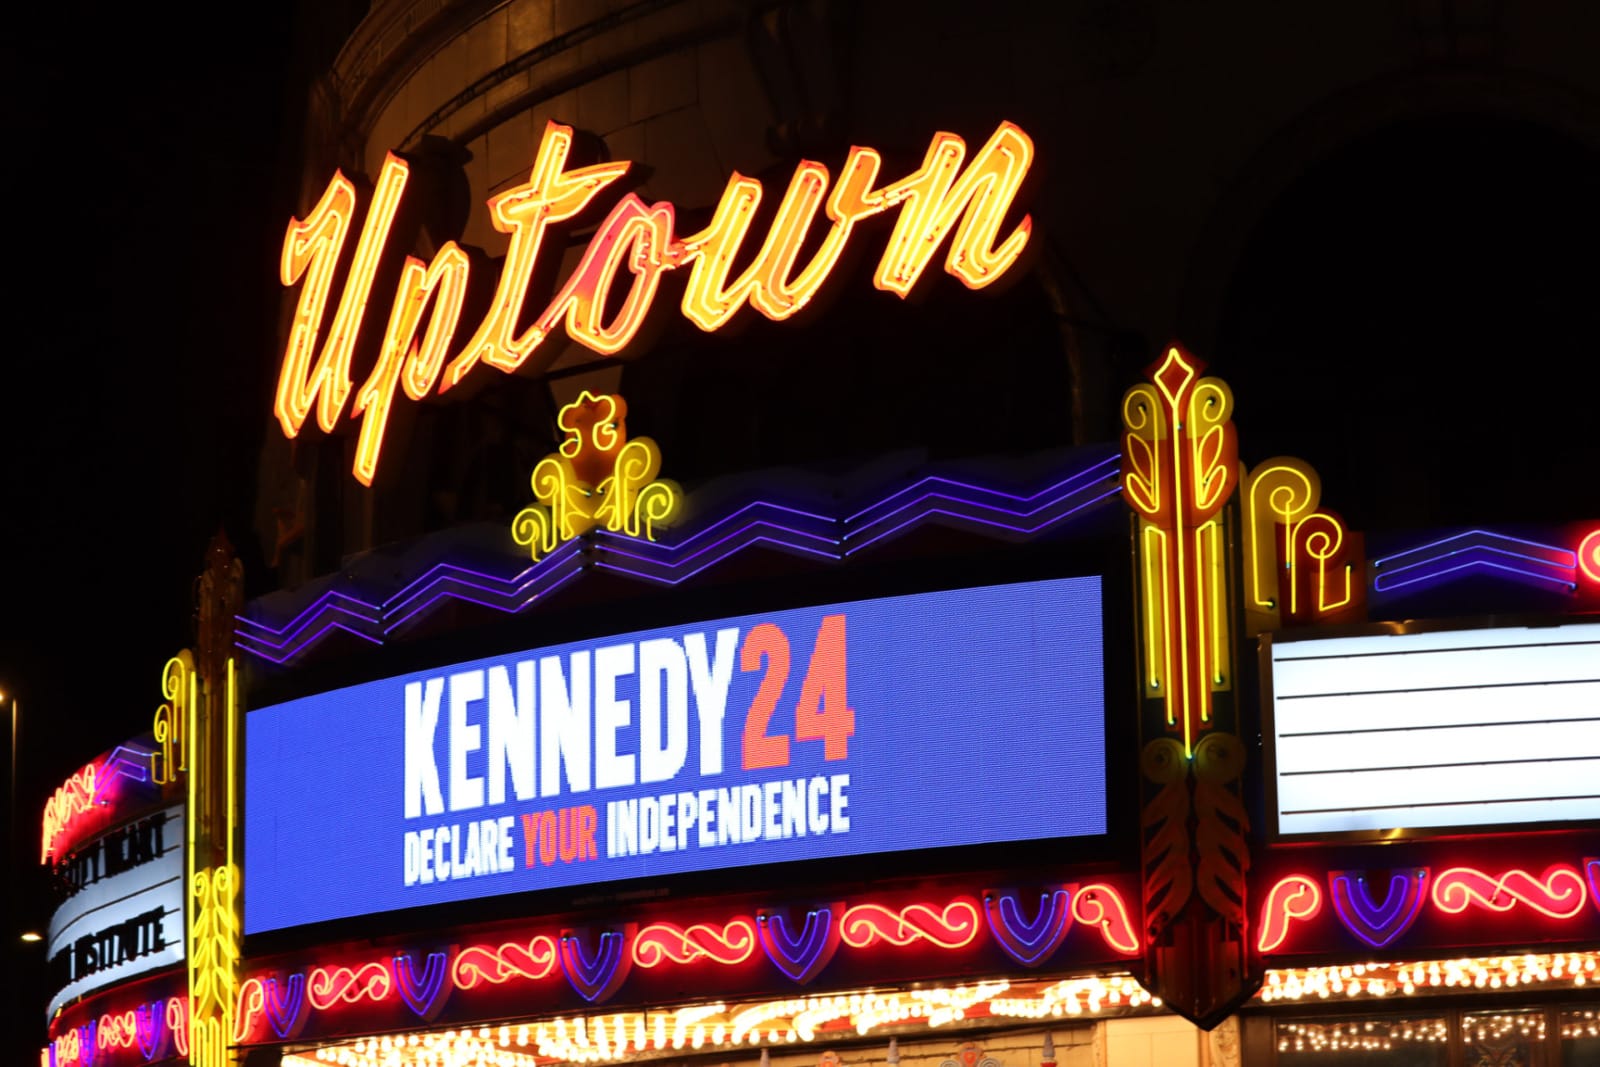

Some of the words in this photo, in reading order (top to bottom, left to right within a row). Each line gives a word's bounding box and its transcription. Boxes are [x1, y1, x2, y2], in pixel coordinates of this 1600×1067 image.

[274, 119, 1034, 487] Uptown
[404, 815, 515, 887] DECLARE
[520, 805, 598, 868] YOUR
[606, 774, 850, 859] INDEPENDENCE
